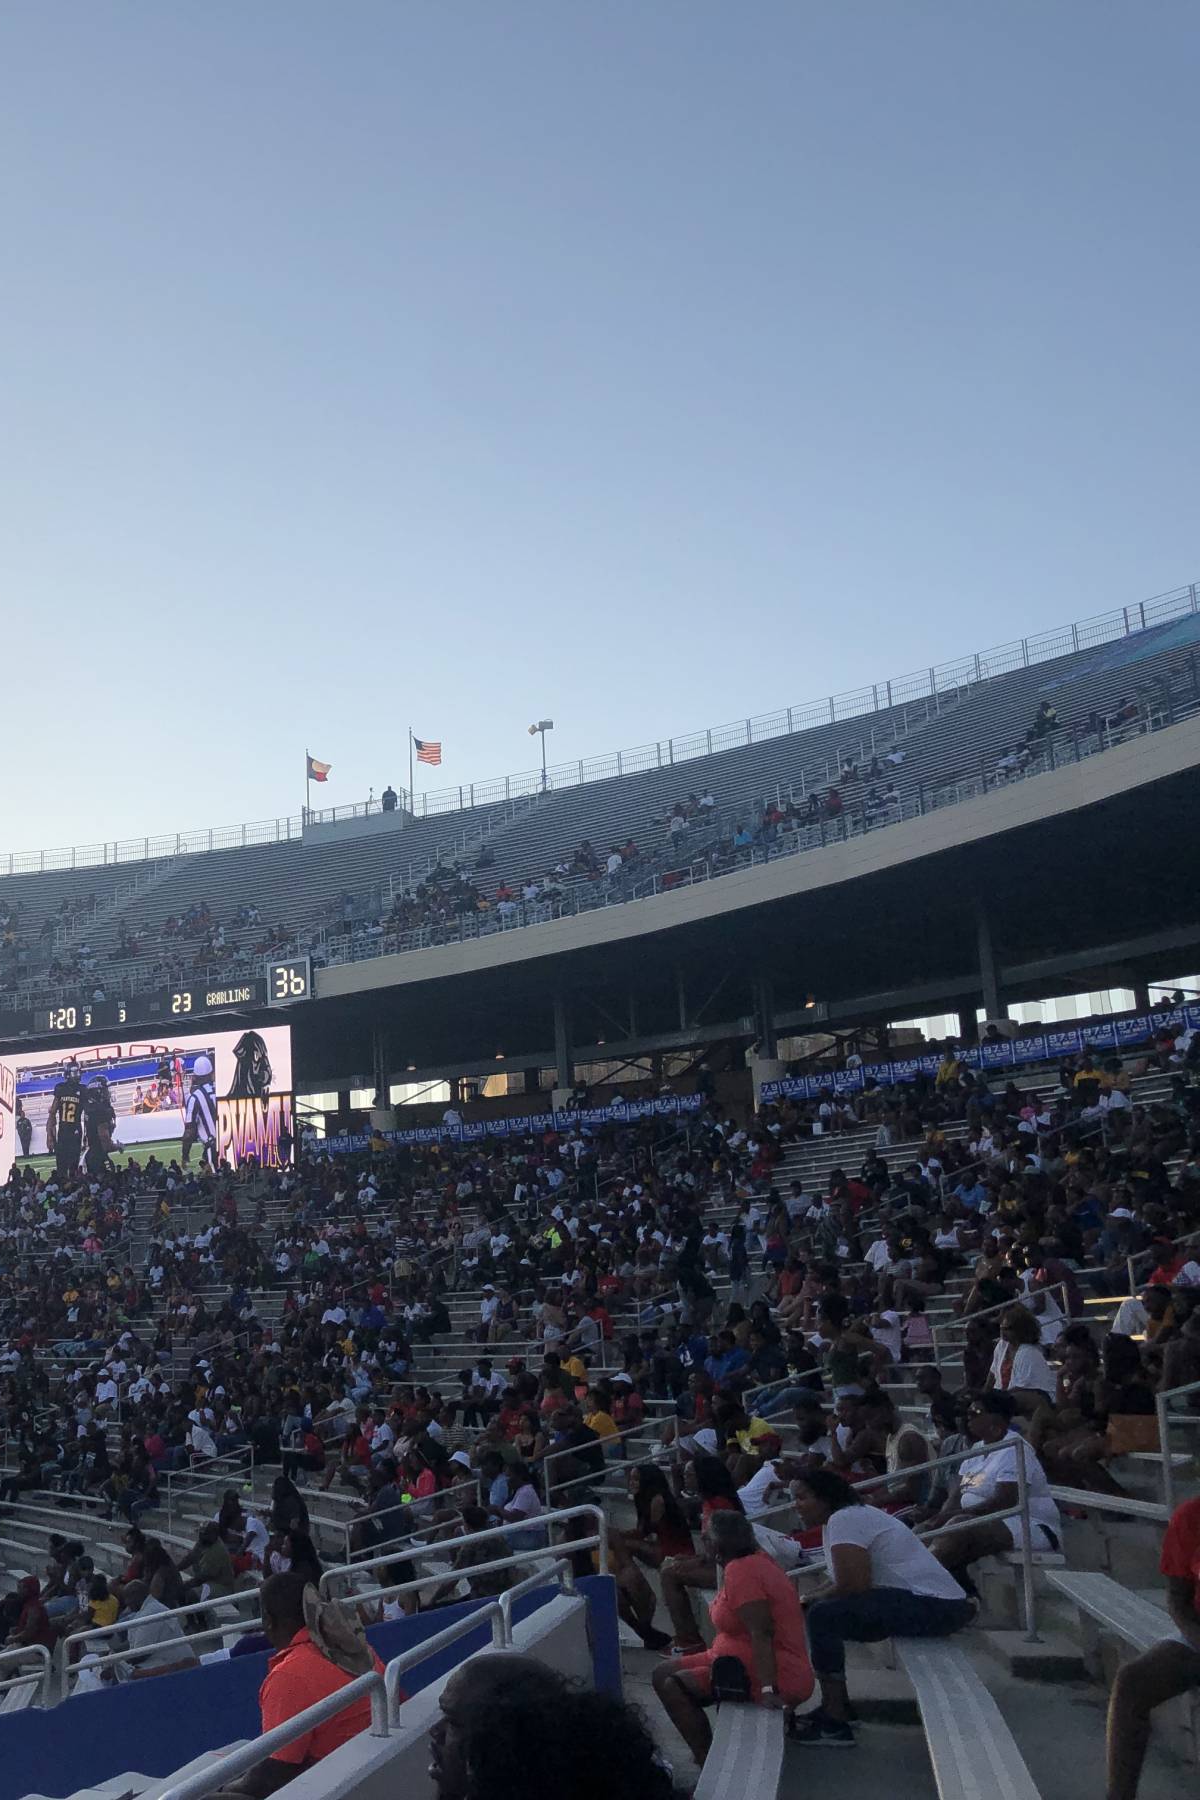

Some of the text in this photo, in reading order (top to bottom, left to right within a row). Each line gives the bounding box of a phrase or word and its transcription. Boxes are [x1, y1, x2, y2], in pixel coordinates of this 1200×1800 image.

[276, 968, 304, 998] 36
[172, 993, 191, 1013] 23
[49, 1007, 76, 1029] 1:20
[85, 1013, 92, 1026] 3
[119, 1009, 126, 1022] 3
[62, 1102, 76, 1122] 12
